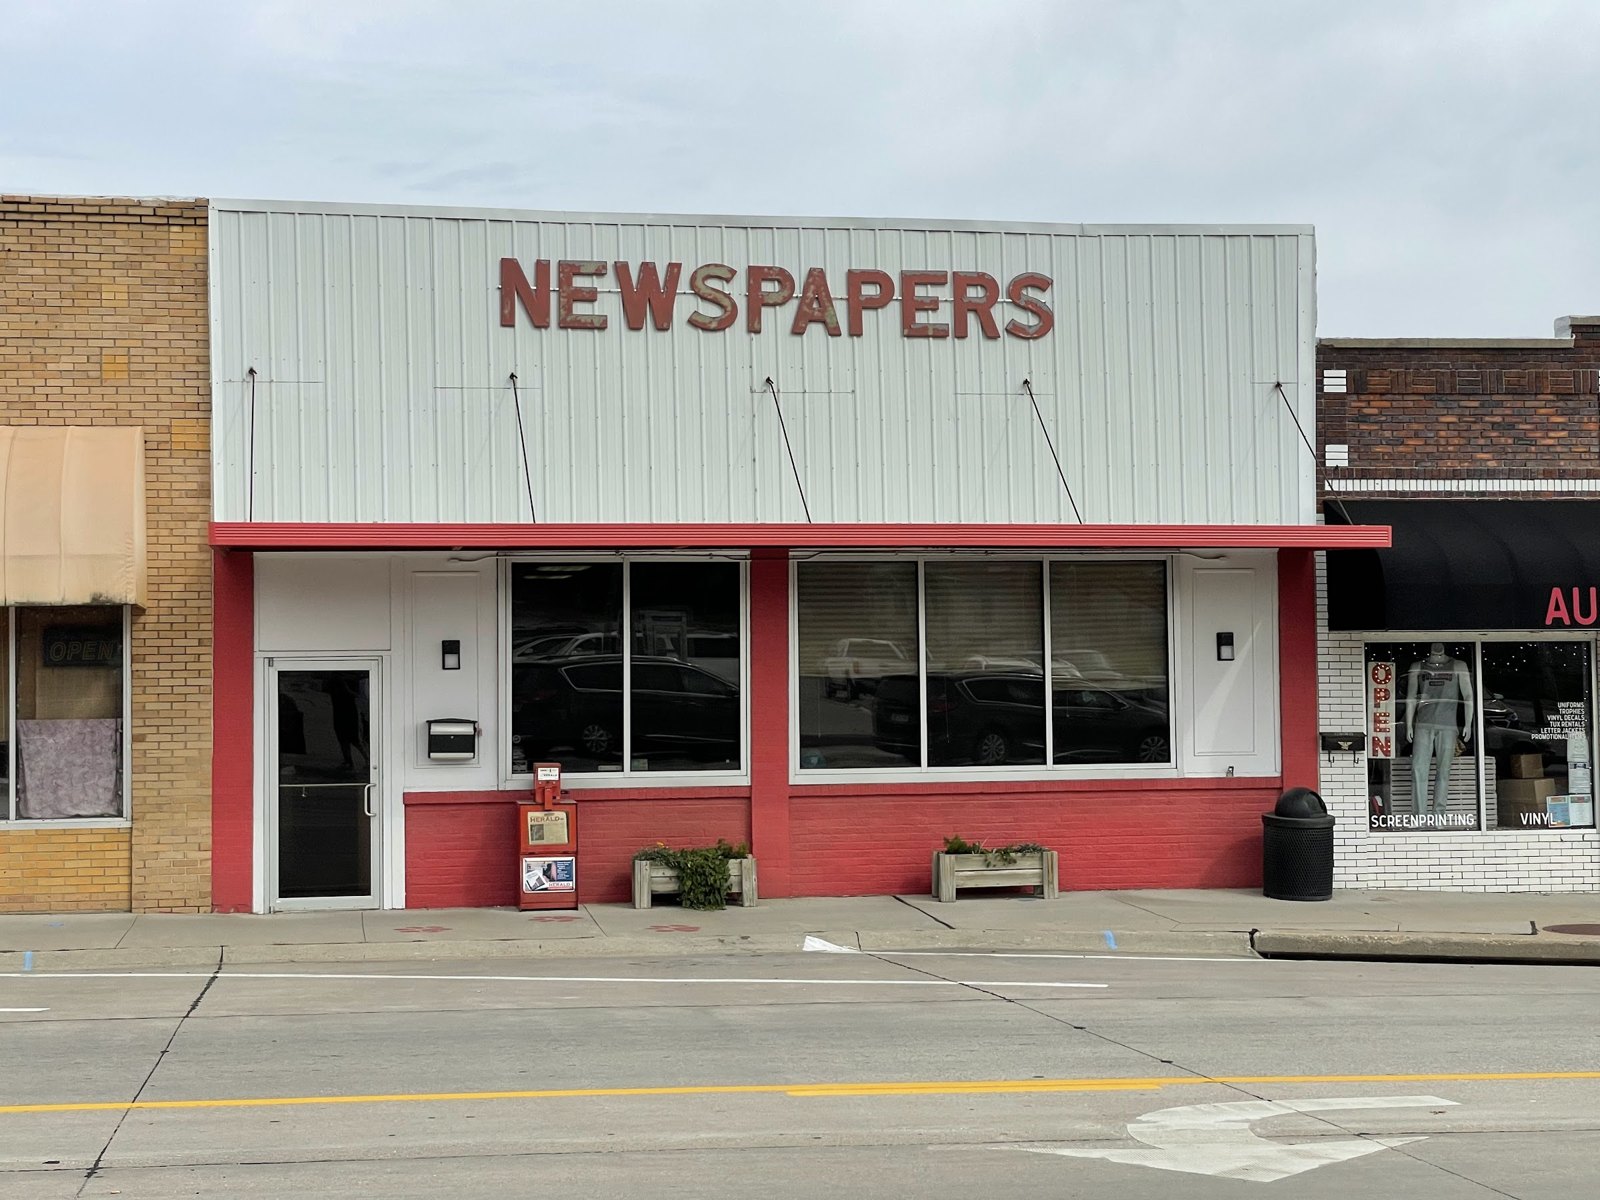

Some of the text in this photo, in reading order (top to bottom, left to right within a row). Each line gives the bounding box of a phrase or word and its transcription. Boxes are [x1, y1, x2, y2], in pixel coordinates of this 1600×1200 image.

[500, 257, 1054, 339] NEWSPAPERS
[1545, 586, 1597, 626] AU
[50, 640, 114, 662] OPEN
[1372, 663, 1392, 757] OPEN
[1371, 813, 1475, 828] SCREENPRINTING
[1520, 812, 1558, 826] VINYL
